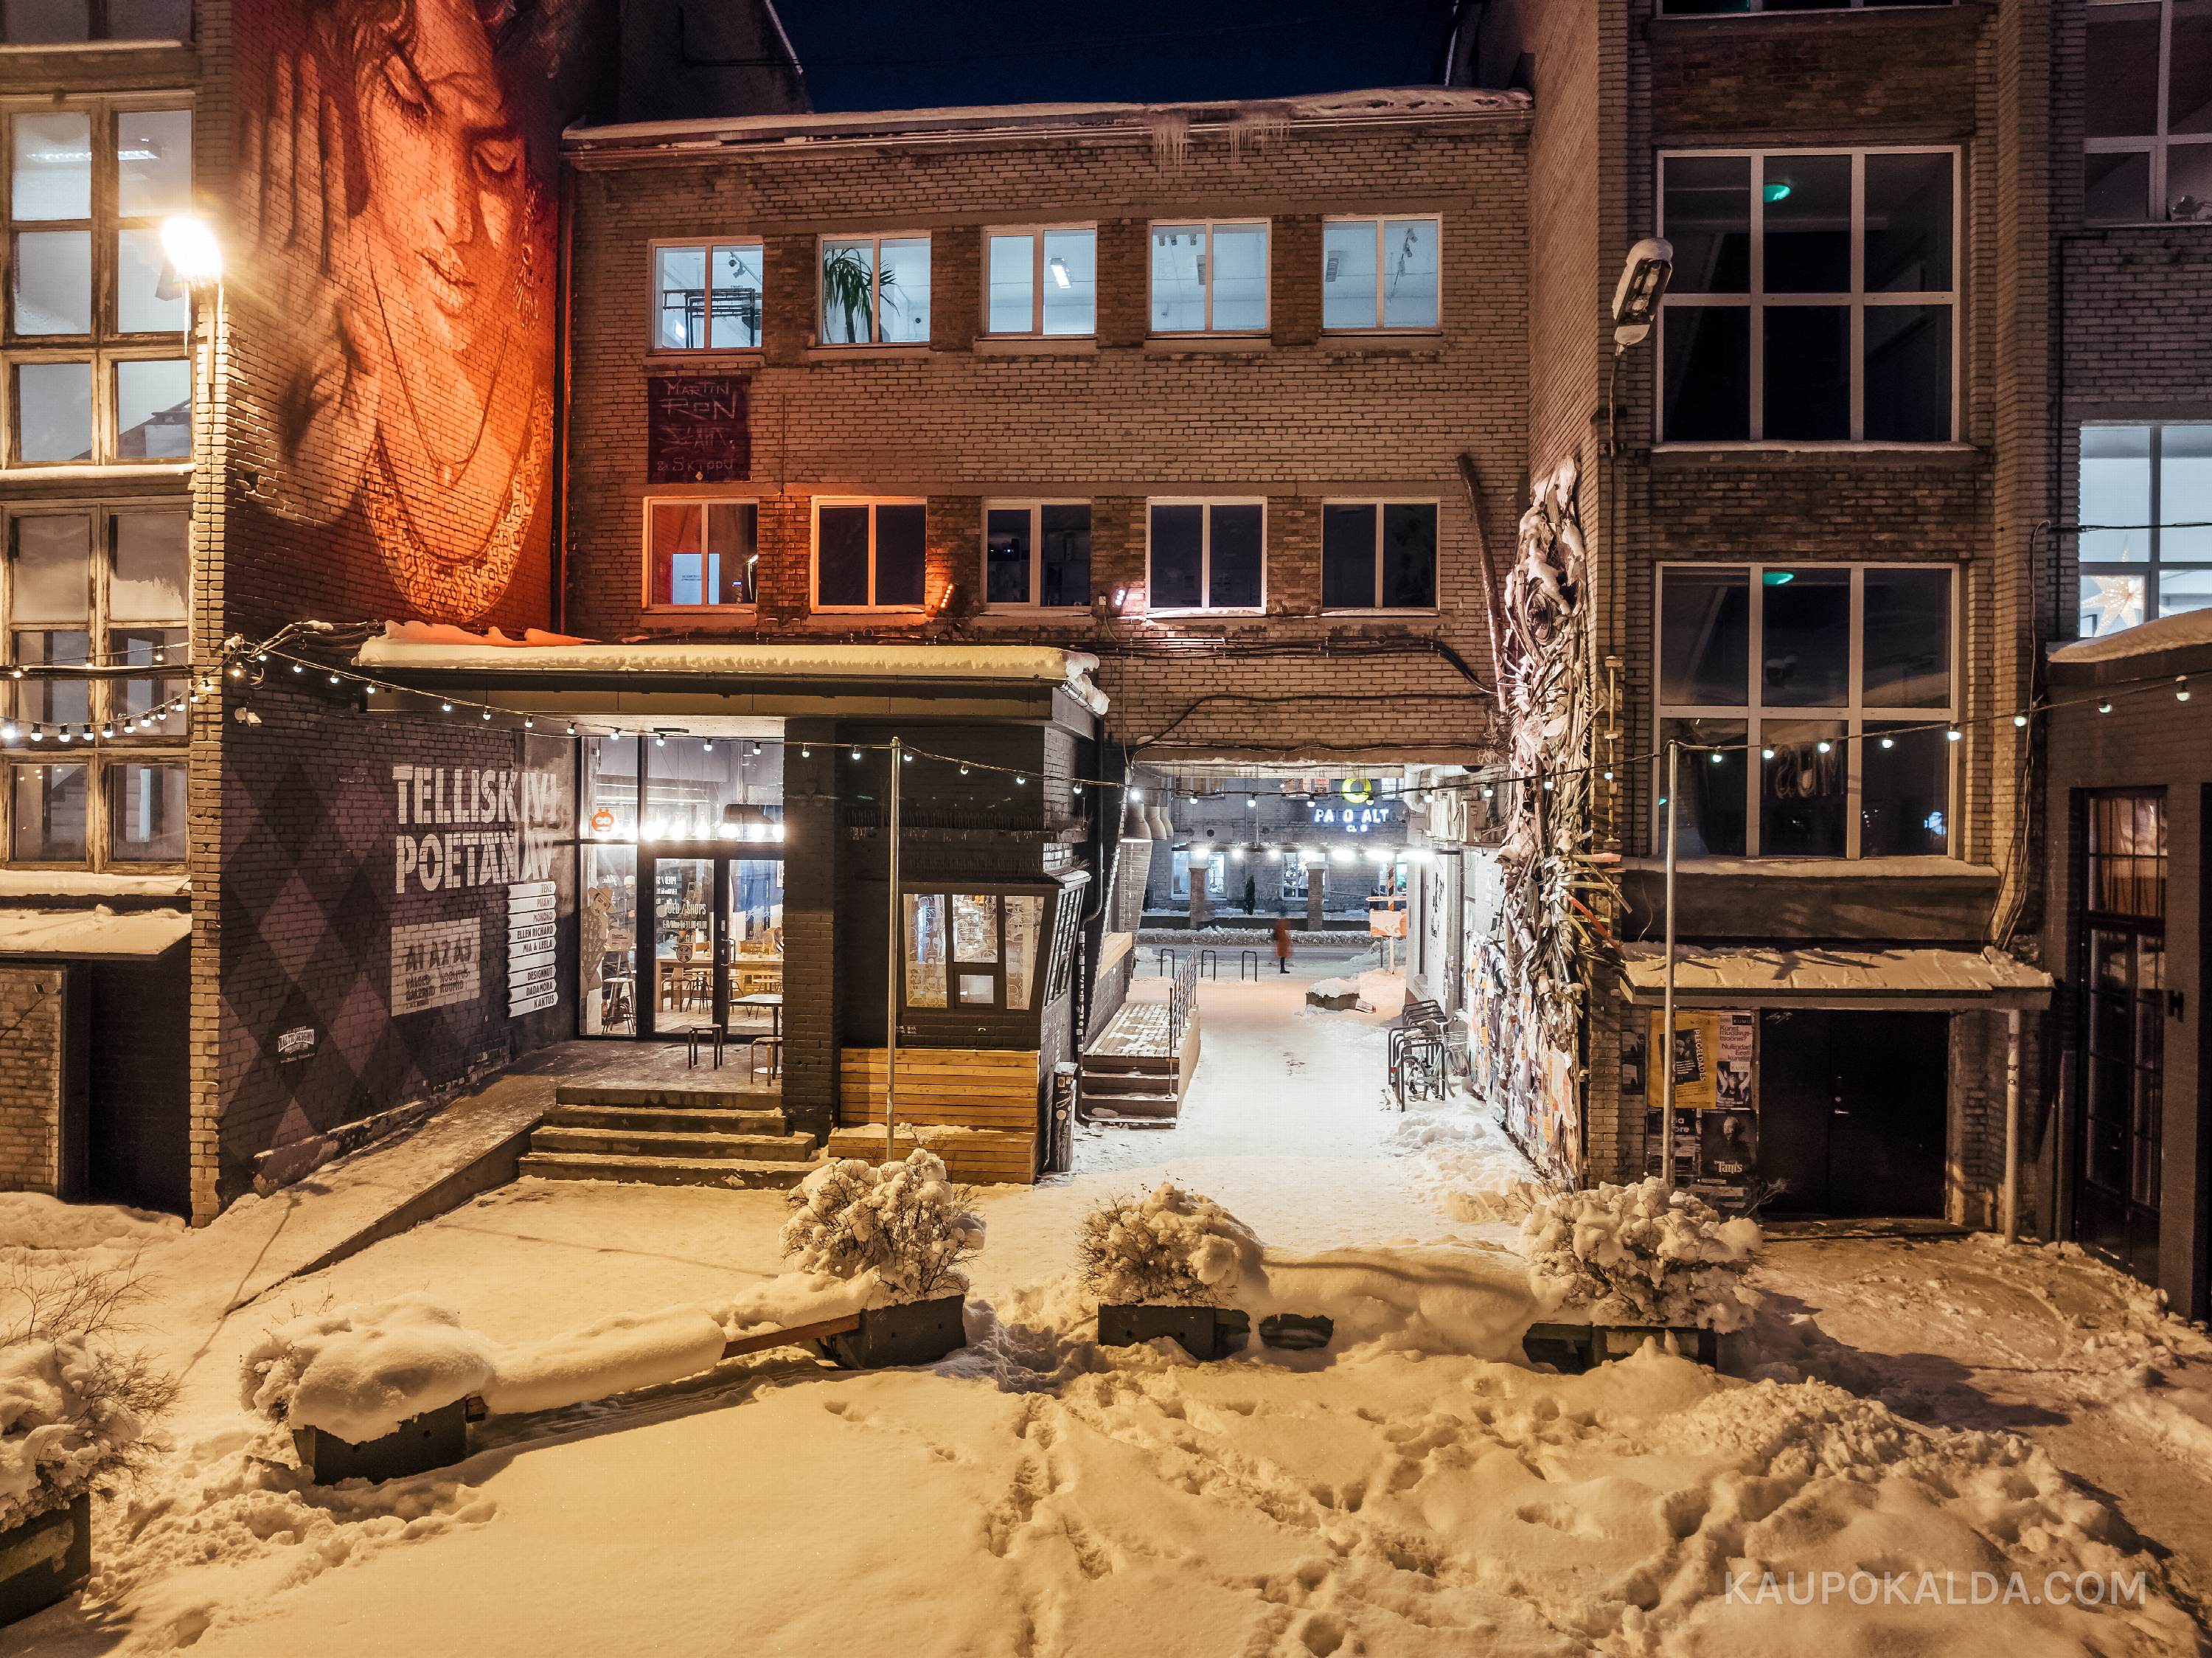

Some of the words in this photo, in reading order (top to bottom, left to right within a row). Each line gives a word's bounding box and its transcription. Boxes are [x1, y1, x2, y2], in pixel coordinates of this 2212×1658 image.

[392, 766, 557, 824] TELLISKIVI
[686, 903, 706, 915] SHOPS
[517, 929, 532, 940] ELLEN
[532, 926, 554, 937] RICHARD
[538, 940, 553, 950] LEELA
[534, 994, 554, 1009] KAKTUS
